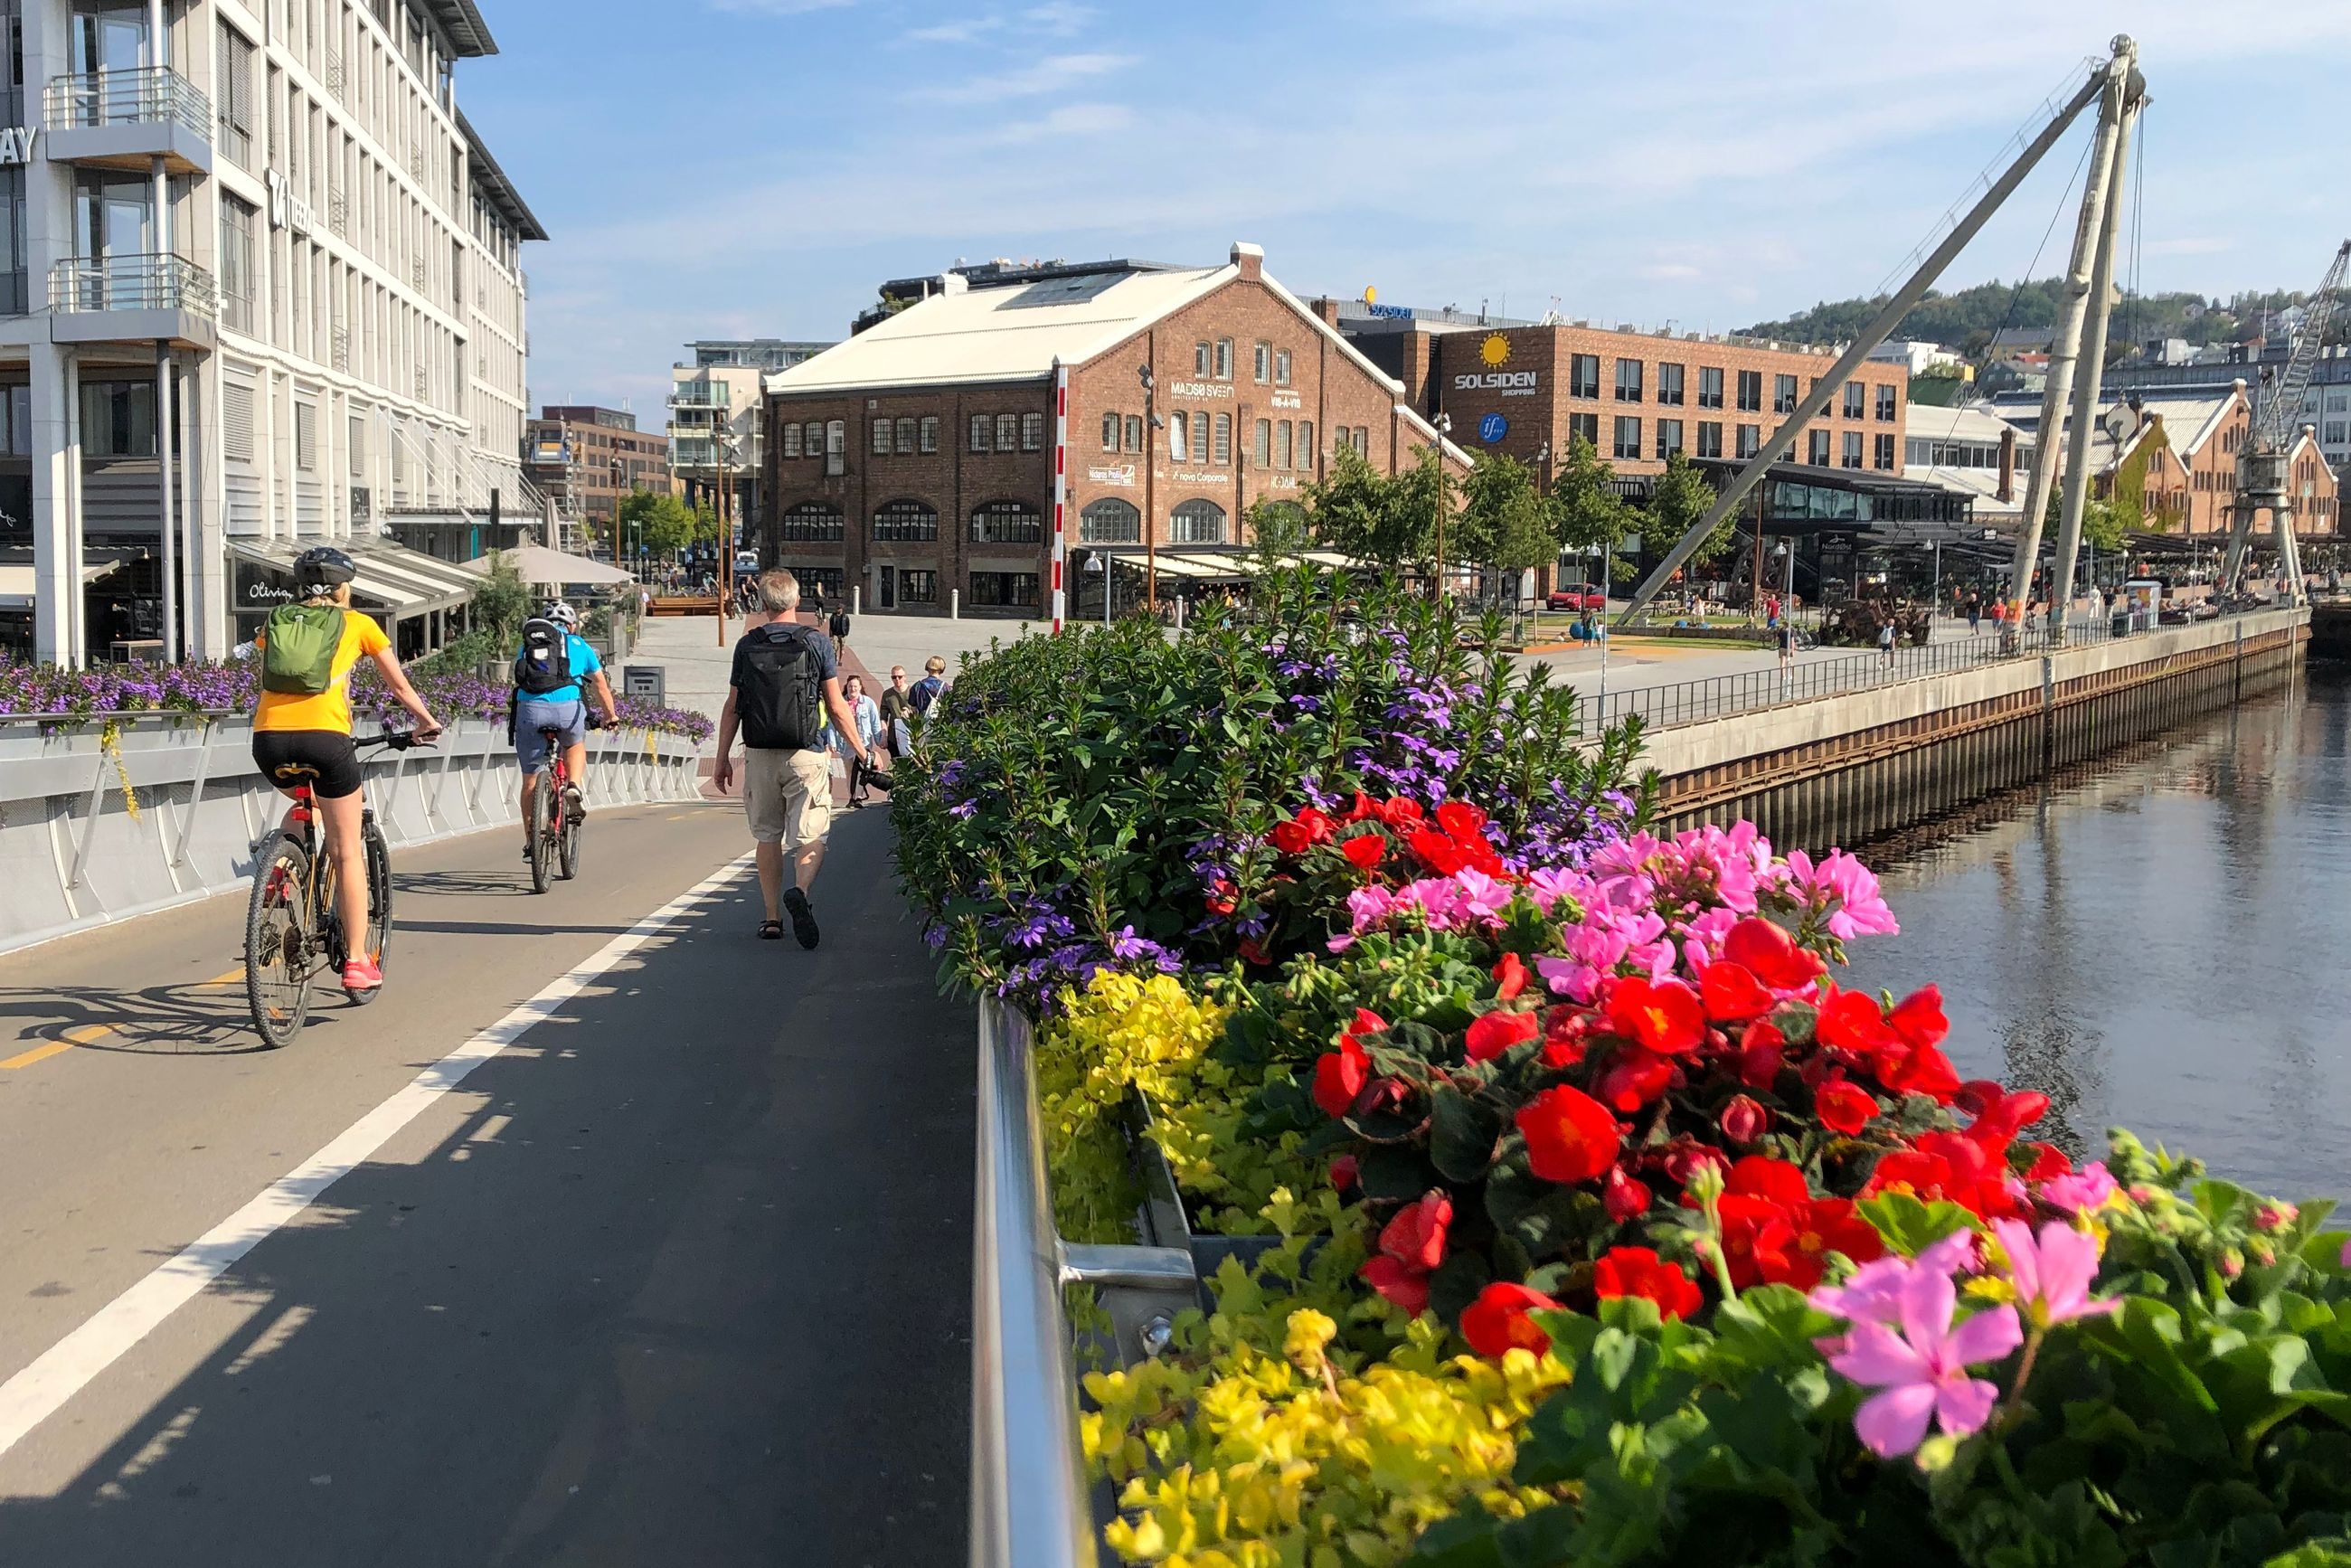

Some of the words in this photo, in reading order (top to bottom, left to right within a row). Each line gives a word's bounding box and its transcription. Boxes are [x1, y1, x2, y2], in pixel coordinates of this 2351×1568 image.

[1171, 381, 1205, 396] MADSØ
[1454, 372, 1536, 390] SOLSIDEN
[1501, 388, 1535, 397] SHOPPING
[1196, 472, 1229, 485] Corporate
[250, 581, 294, 599] Olivia
